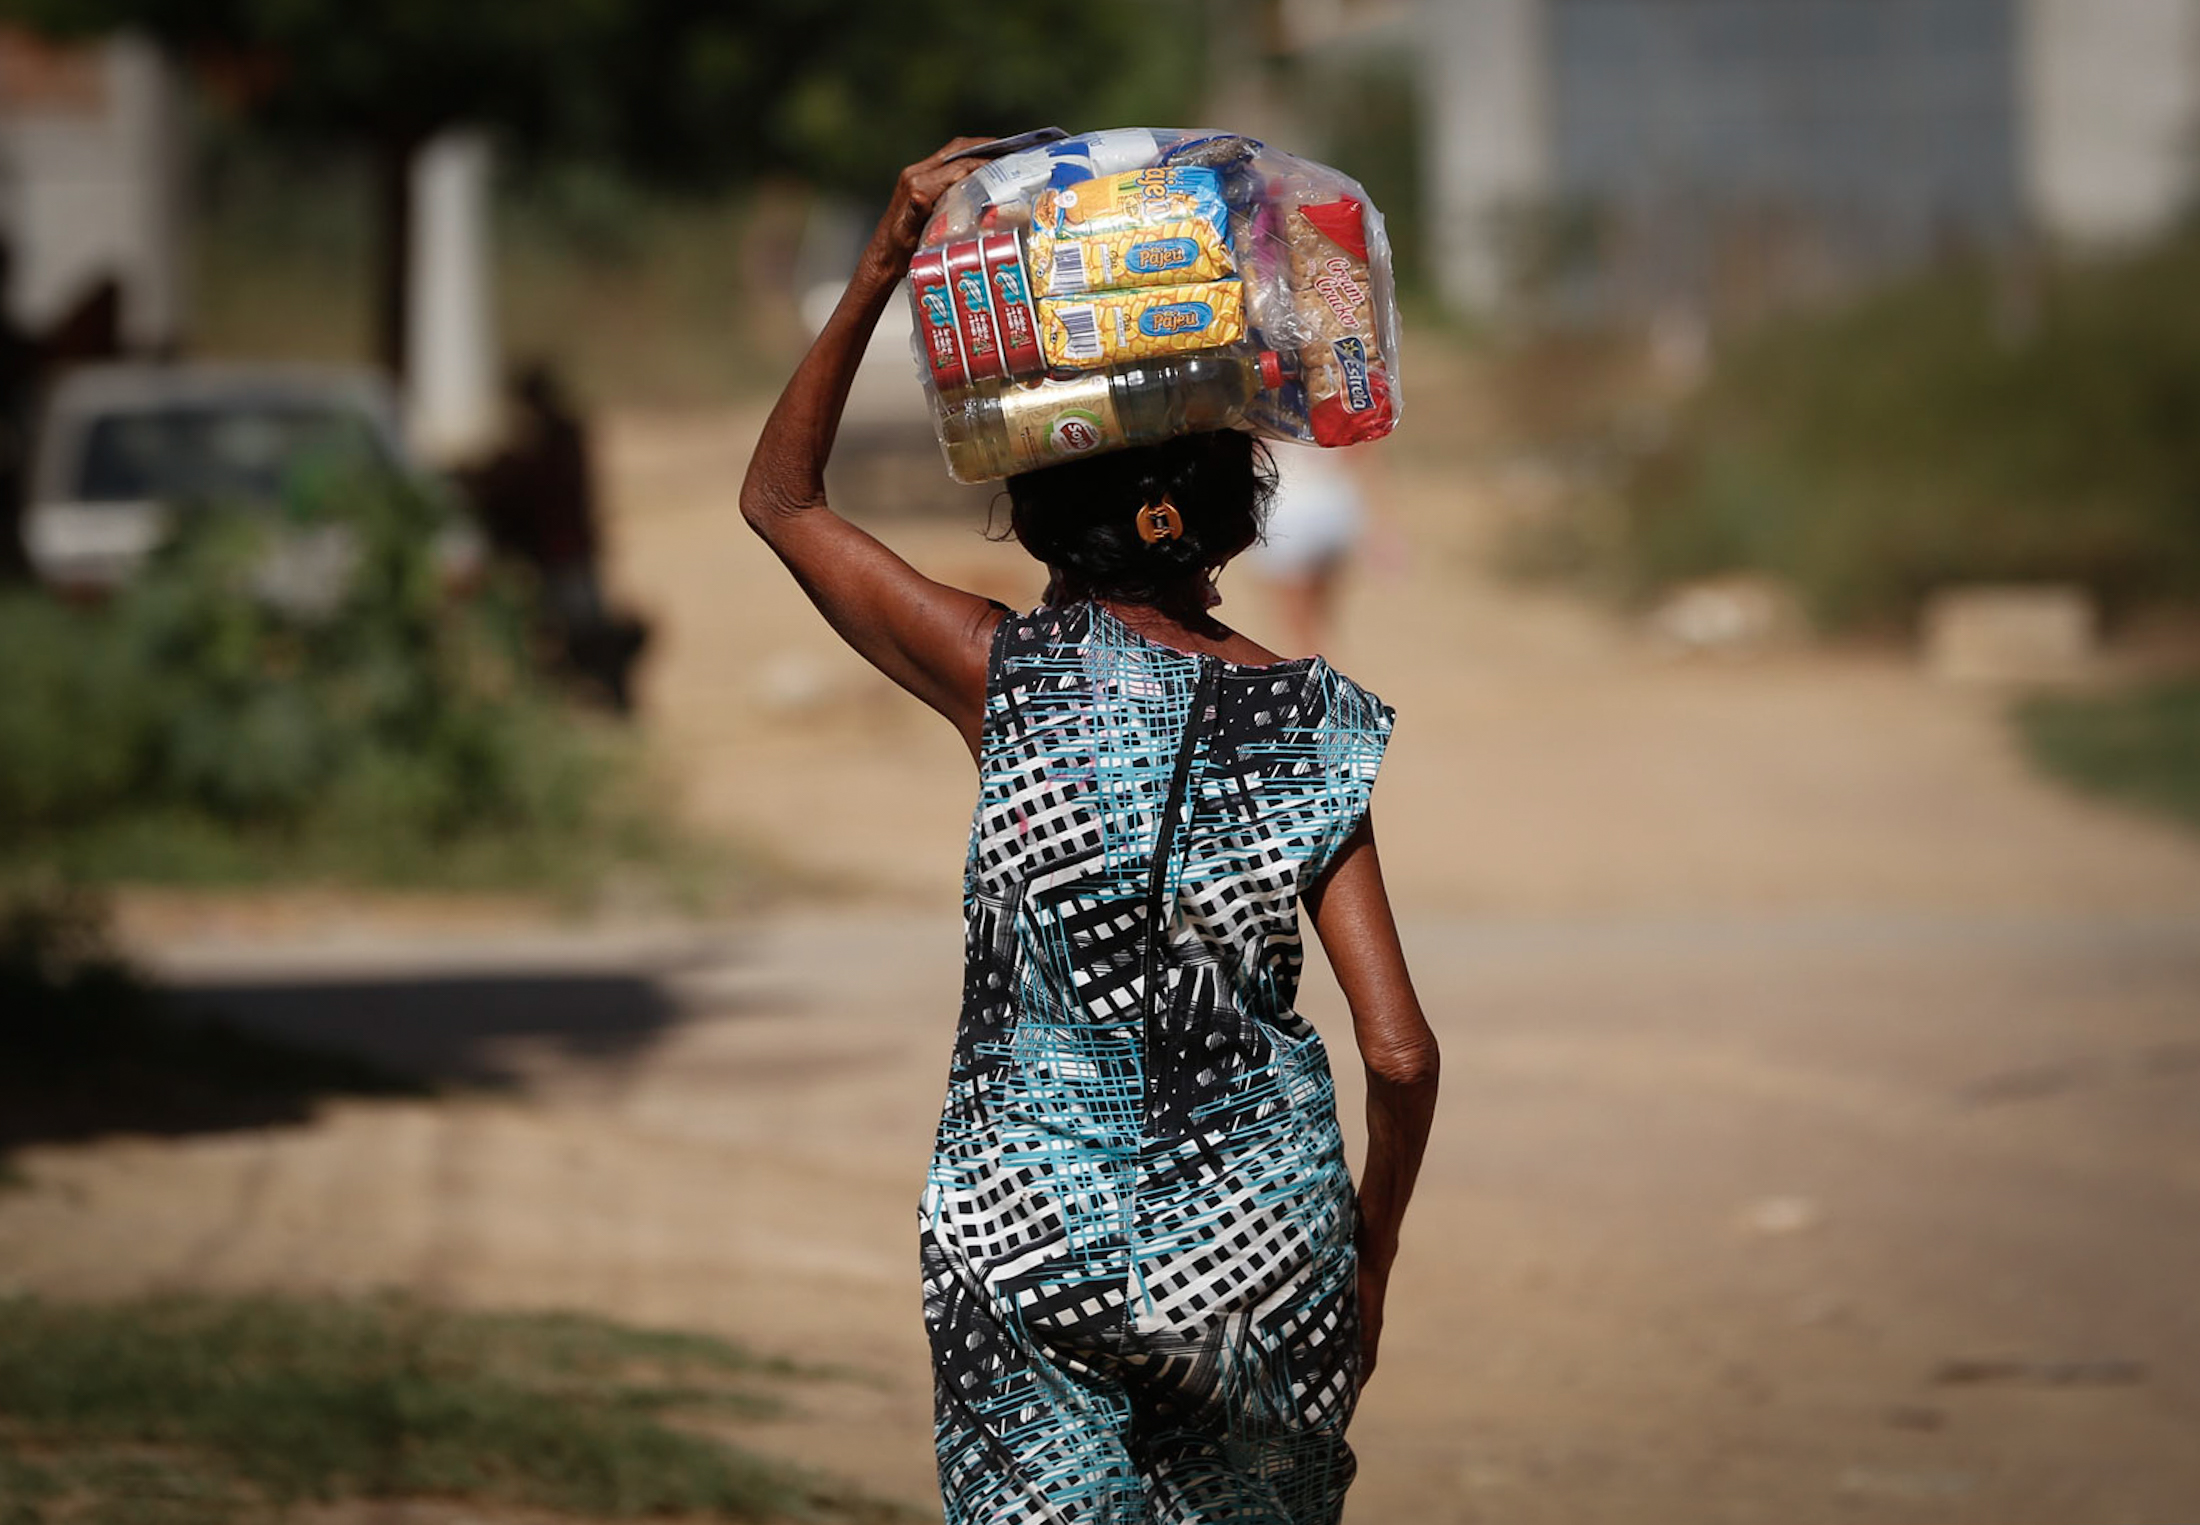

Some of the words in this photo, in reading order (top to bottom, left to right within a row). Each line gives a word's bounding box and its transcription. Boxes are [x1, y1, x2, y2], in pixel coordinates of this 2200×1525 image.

[1314, 277, 1360, 329] Cracker
[1326, 257, 1365, 305] Cream
[1344, 360, 1368, 408] Estrela
